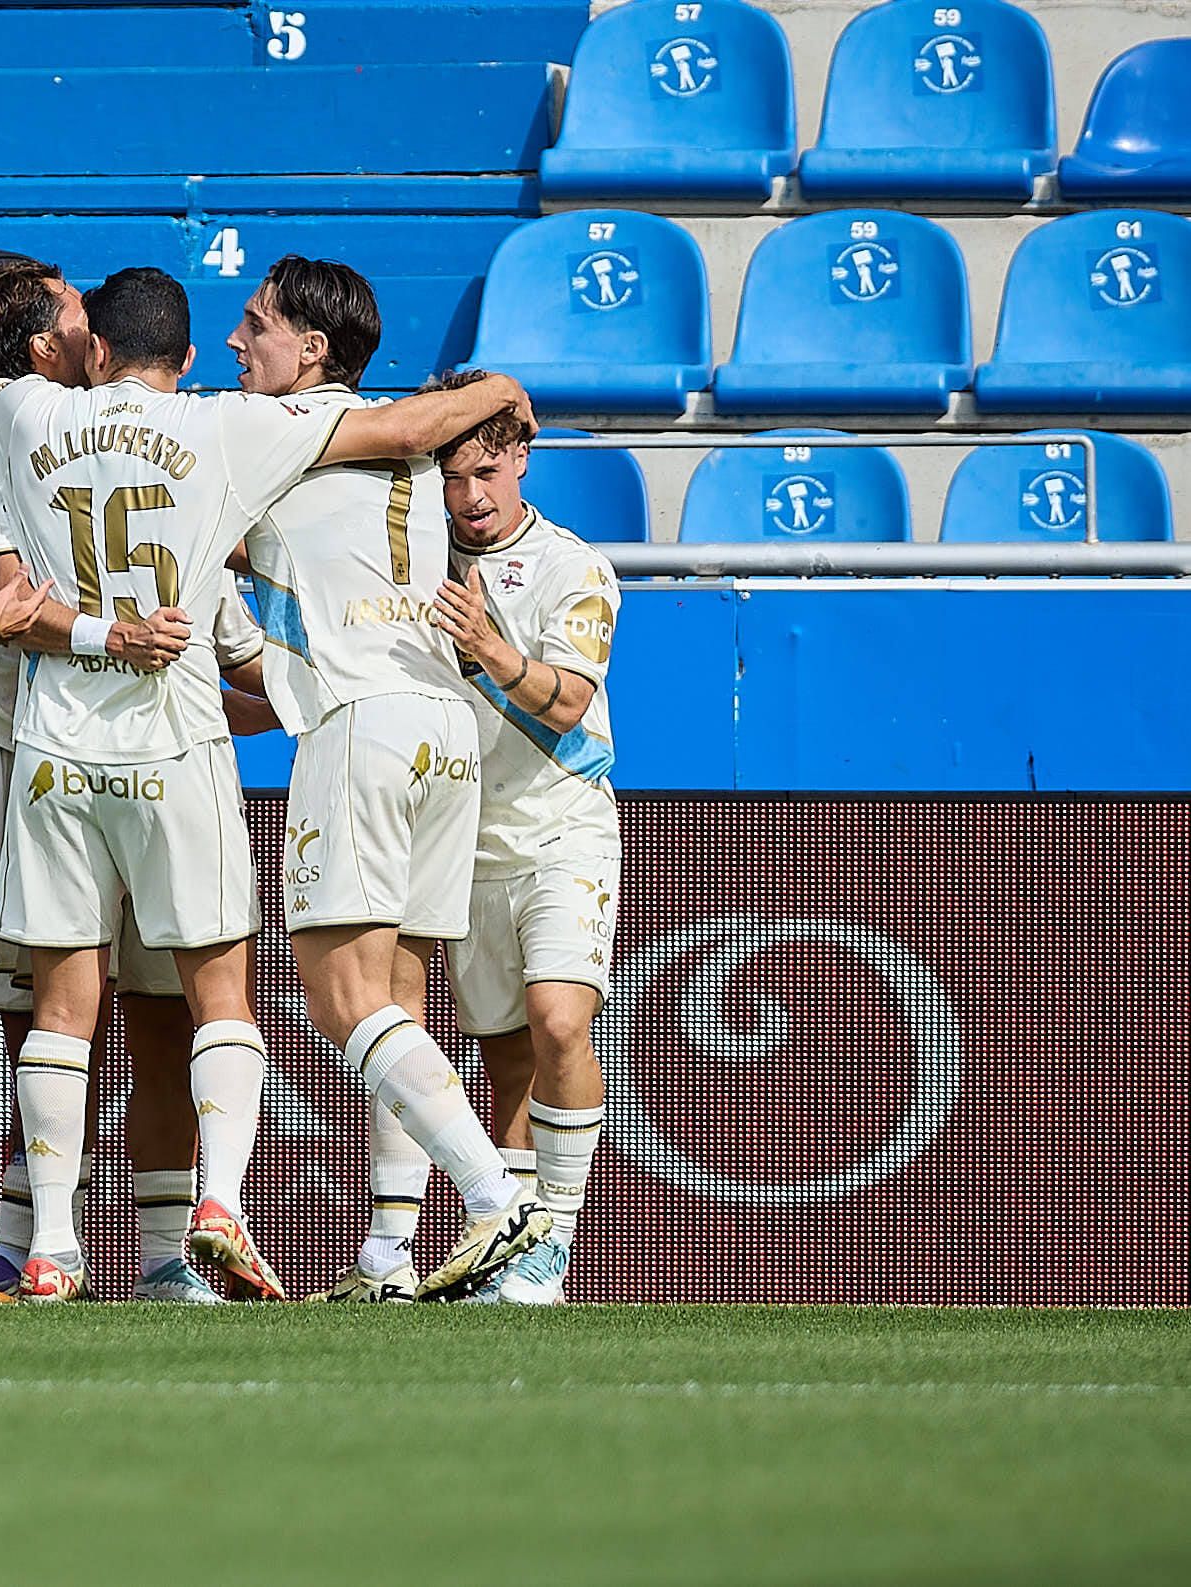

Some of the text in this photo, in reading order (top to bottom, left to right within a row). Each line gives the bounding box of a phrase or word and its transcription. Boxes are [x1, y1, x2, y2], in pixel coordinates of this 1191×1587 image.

[675, 4, 702, 21] 57
[934, 9, 961, 26] 59
[267, 11, 306, 60] 5
[589, 223, 616, 240] 57
[851, 222, 878, 239] 59
[1116, 221, 1142, 239] 61
[202, 228, 244, 277] 4
[784, 447, 811, 462] 59
[1045, 444, 1071, 459] 61
[49, 484, 179, 624] 15
